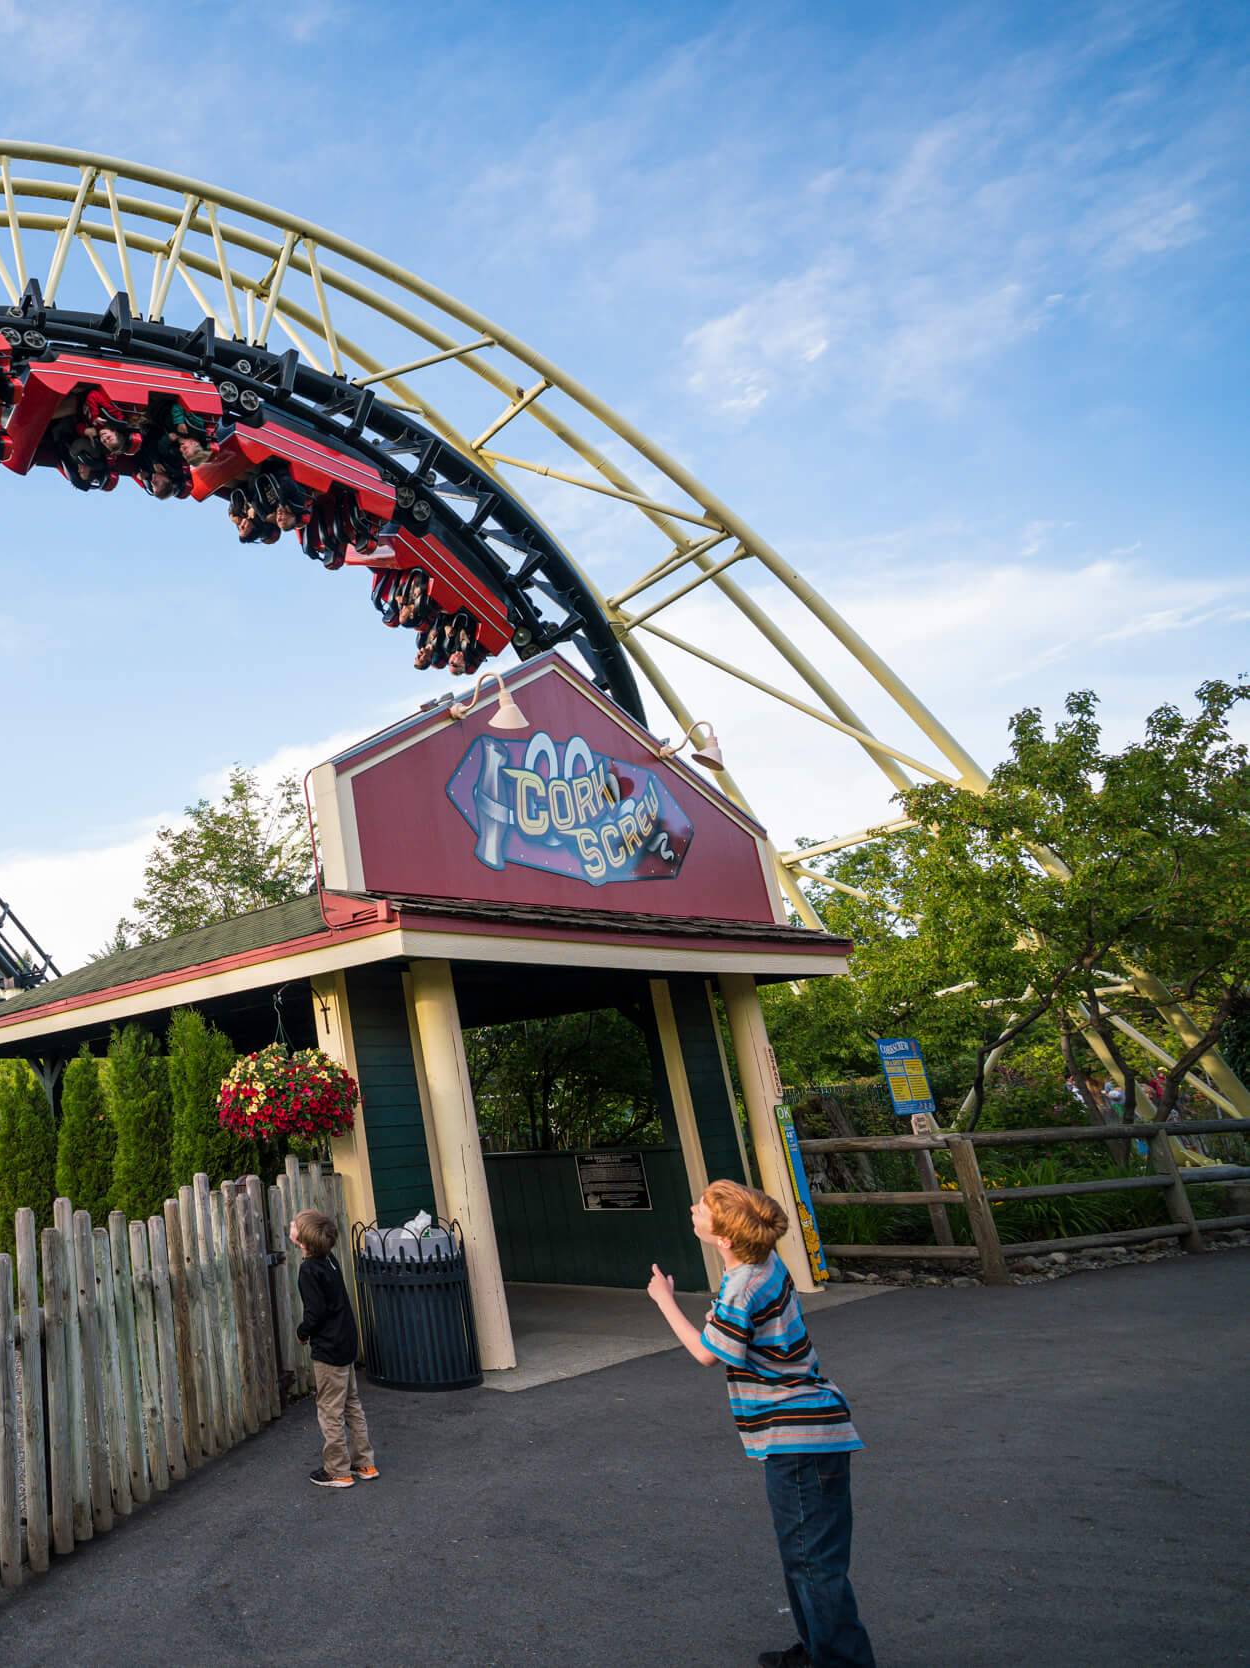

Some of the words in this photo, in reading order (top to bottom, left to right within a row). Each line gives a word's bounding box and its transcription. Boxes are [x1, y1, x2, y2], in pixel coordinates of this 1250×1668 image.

[502, 763, 617, 836] CORK
[558, 781, 659, 878] SCREW
[776, 1106, 791, 1120] OK
